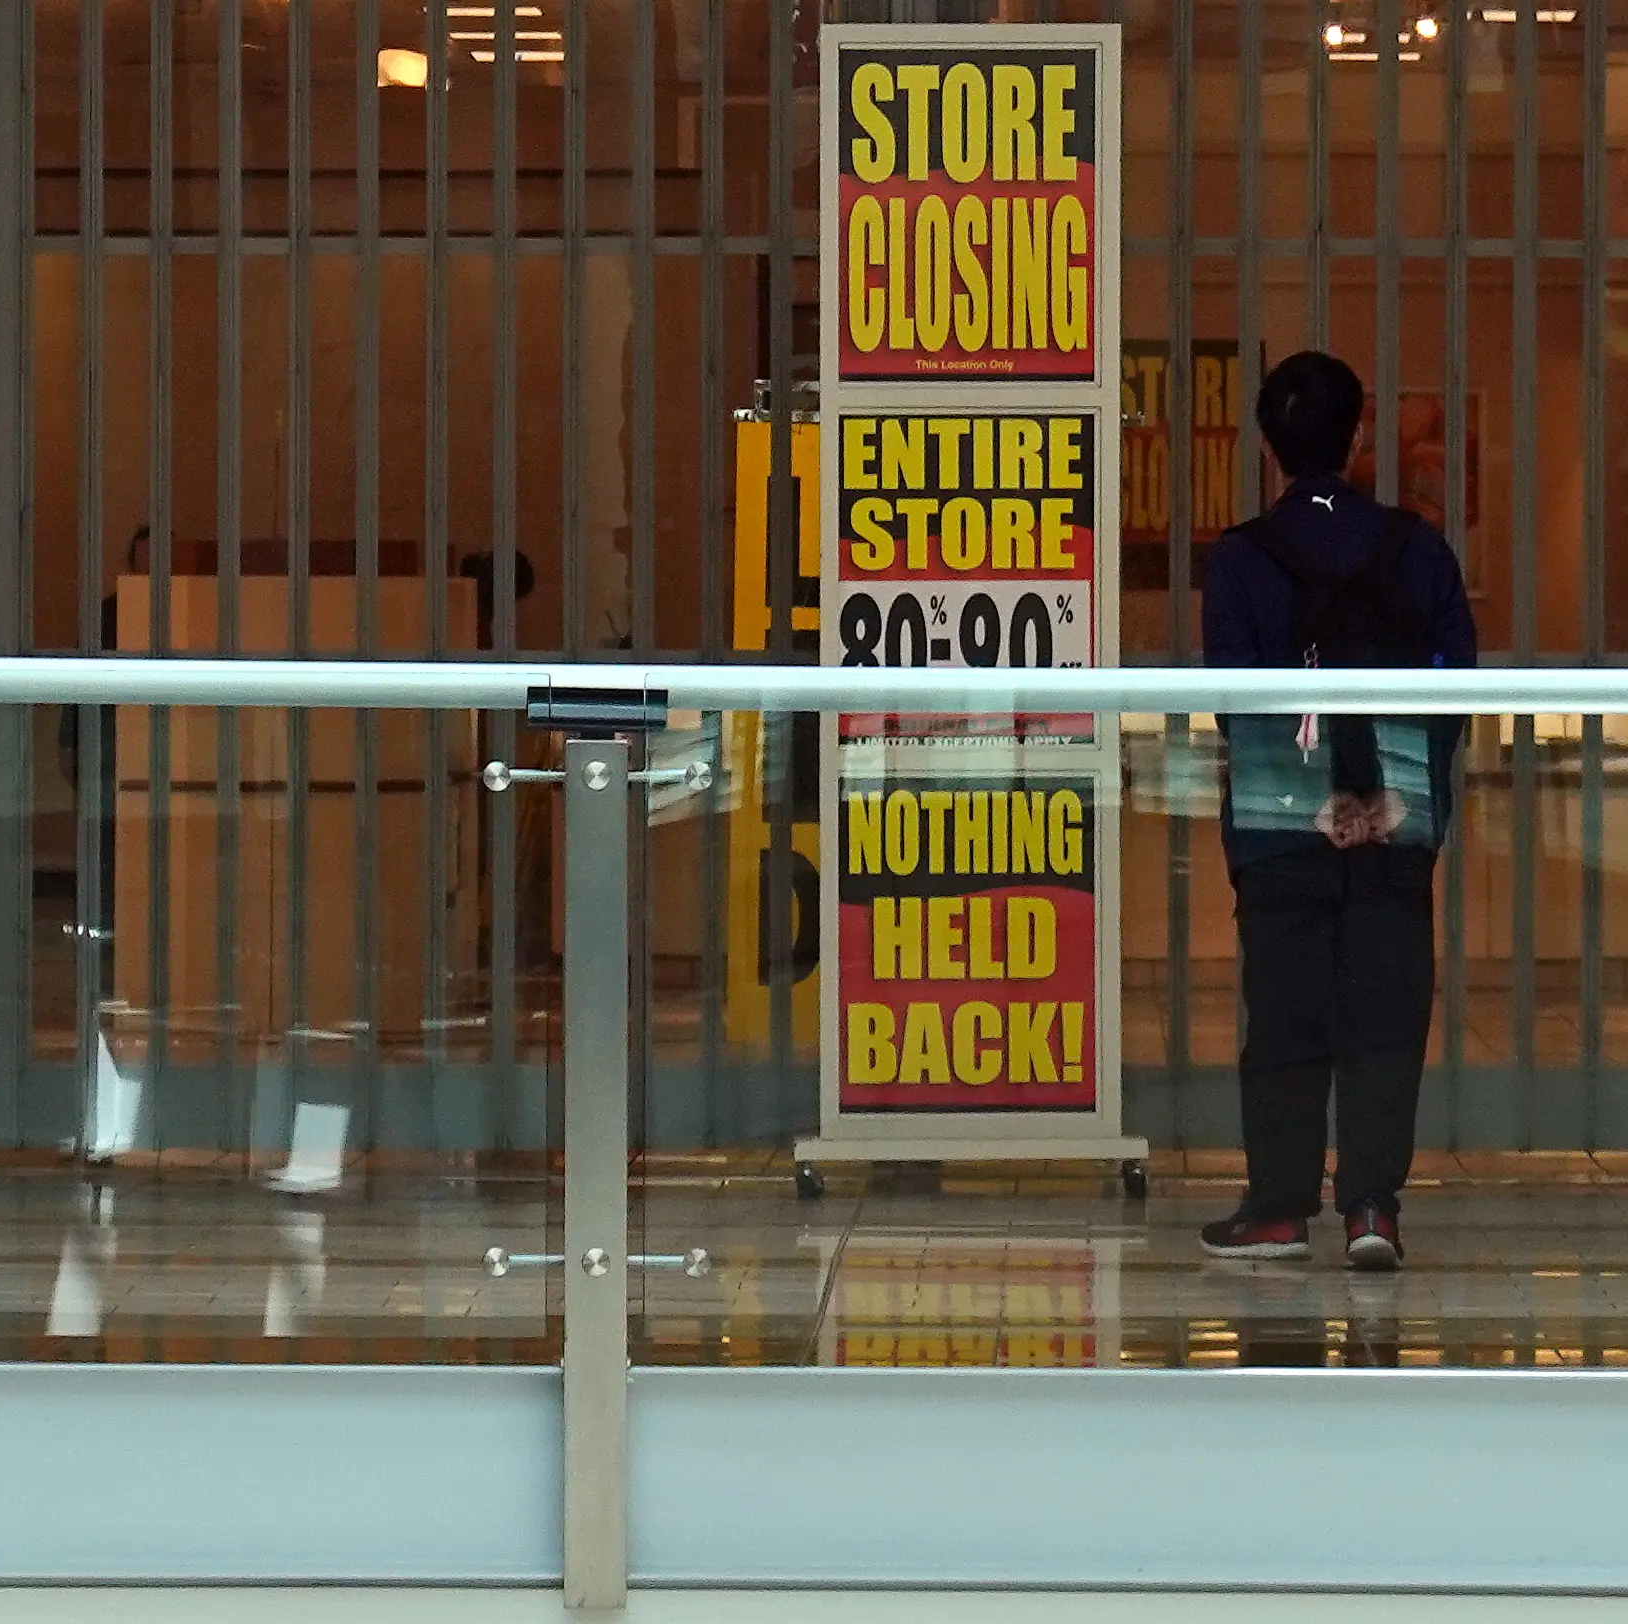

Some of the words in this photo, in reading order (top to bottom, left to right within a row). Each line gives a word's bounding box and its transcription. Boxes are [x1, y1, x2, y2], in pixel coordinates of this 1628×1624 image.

[851, 63, 1077, 183] STORE
[848, 194, 1087, 352] CLOSING
[915, 359, 938, 370] This
[941, 360, 987, 370] Location
[990, 359, 1015, 373] Only
[843, 418, 1083, 490] ENTIRE
[850, 497, 1075, 570] STORE
[848, 789, 1083, 875] NOTHING
[873, 896, 1056, 980] HELD
[847, 1001, 1084, 1084] BACK!
